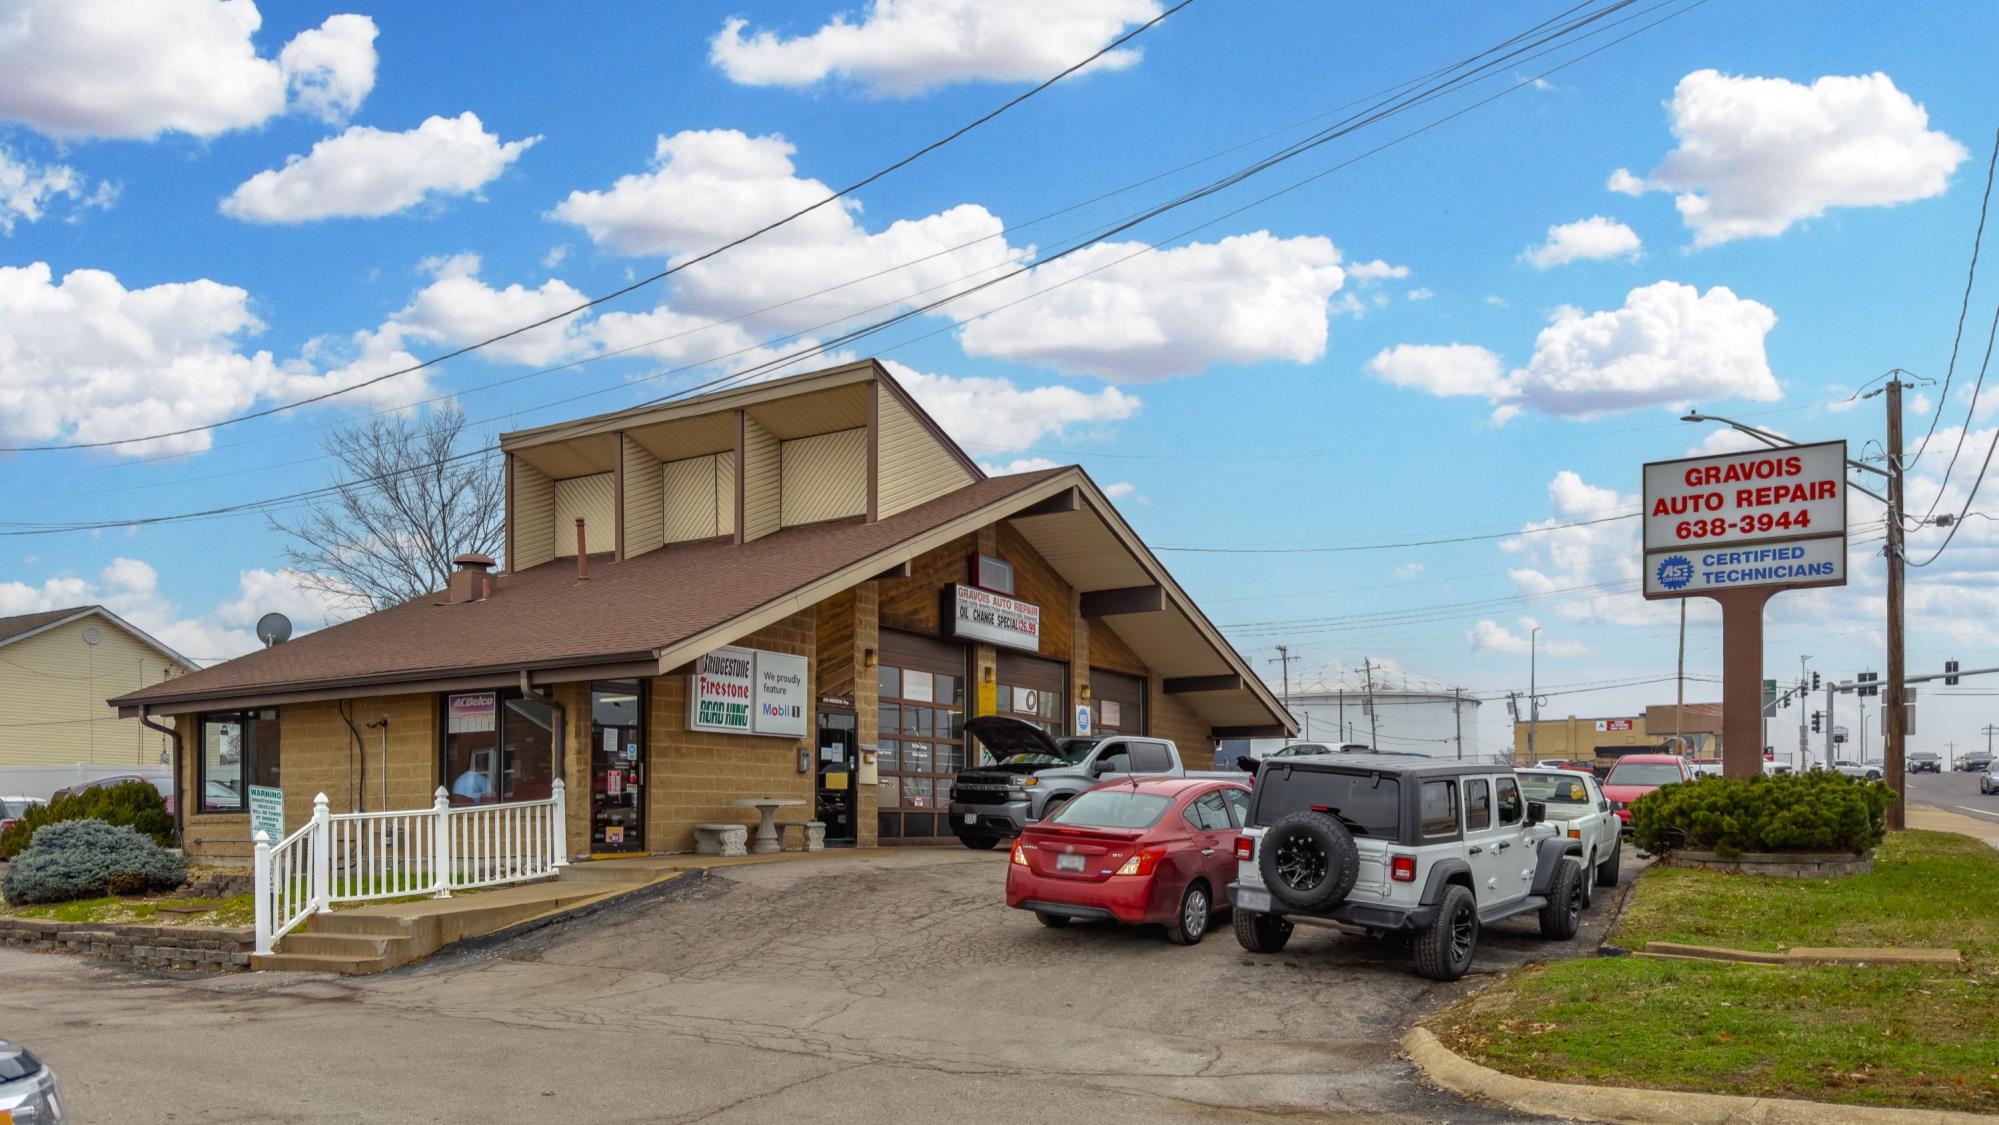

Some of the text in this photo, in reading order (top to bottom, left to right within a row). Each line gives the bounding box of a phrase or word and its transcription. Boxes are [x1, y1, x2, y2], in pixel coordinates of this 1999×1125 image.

[1684, 456, 1802, 487] GRAVOIS
[1652, 480, 1837, 517] AUTO REPAIR
[1675, 509, 1811, 540] 638-3944
[1702, 546, 1806, 568] CERTIFIED
[1662, 565, 1688, 577] ASE
[1702, 562, 1835, 585] TECHNICIANS
[958, 587, 1038, 617] GRAVOIS AUTO REPAIR
[960, 606, 969, 619] OIL
[973, 609, 995, 625] CHANGE
[997, 615, 1018, 631] SPECIAL
[700, 676, 749, 699] Firestone
[763, 672, 801, 686] We proudly
[763, 684, 787, 695] feature
[454, 696, 494, 707] ACDelco
[763, 703, 801, 718] Mobil 1
[251, 789, 281, 799] WARNING
